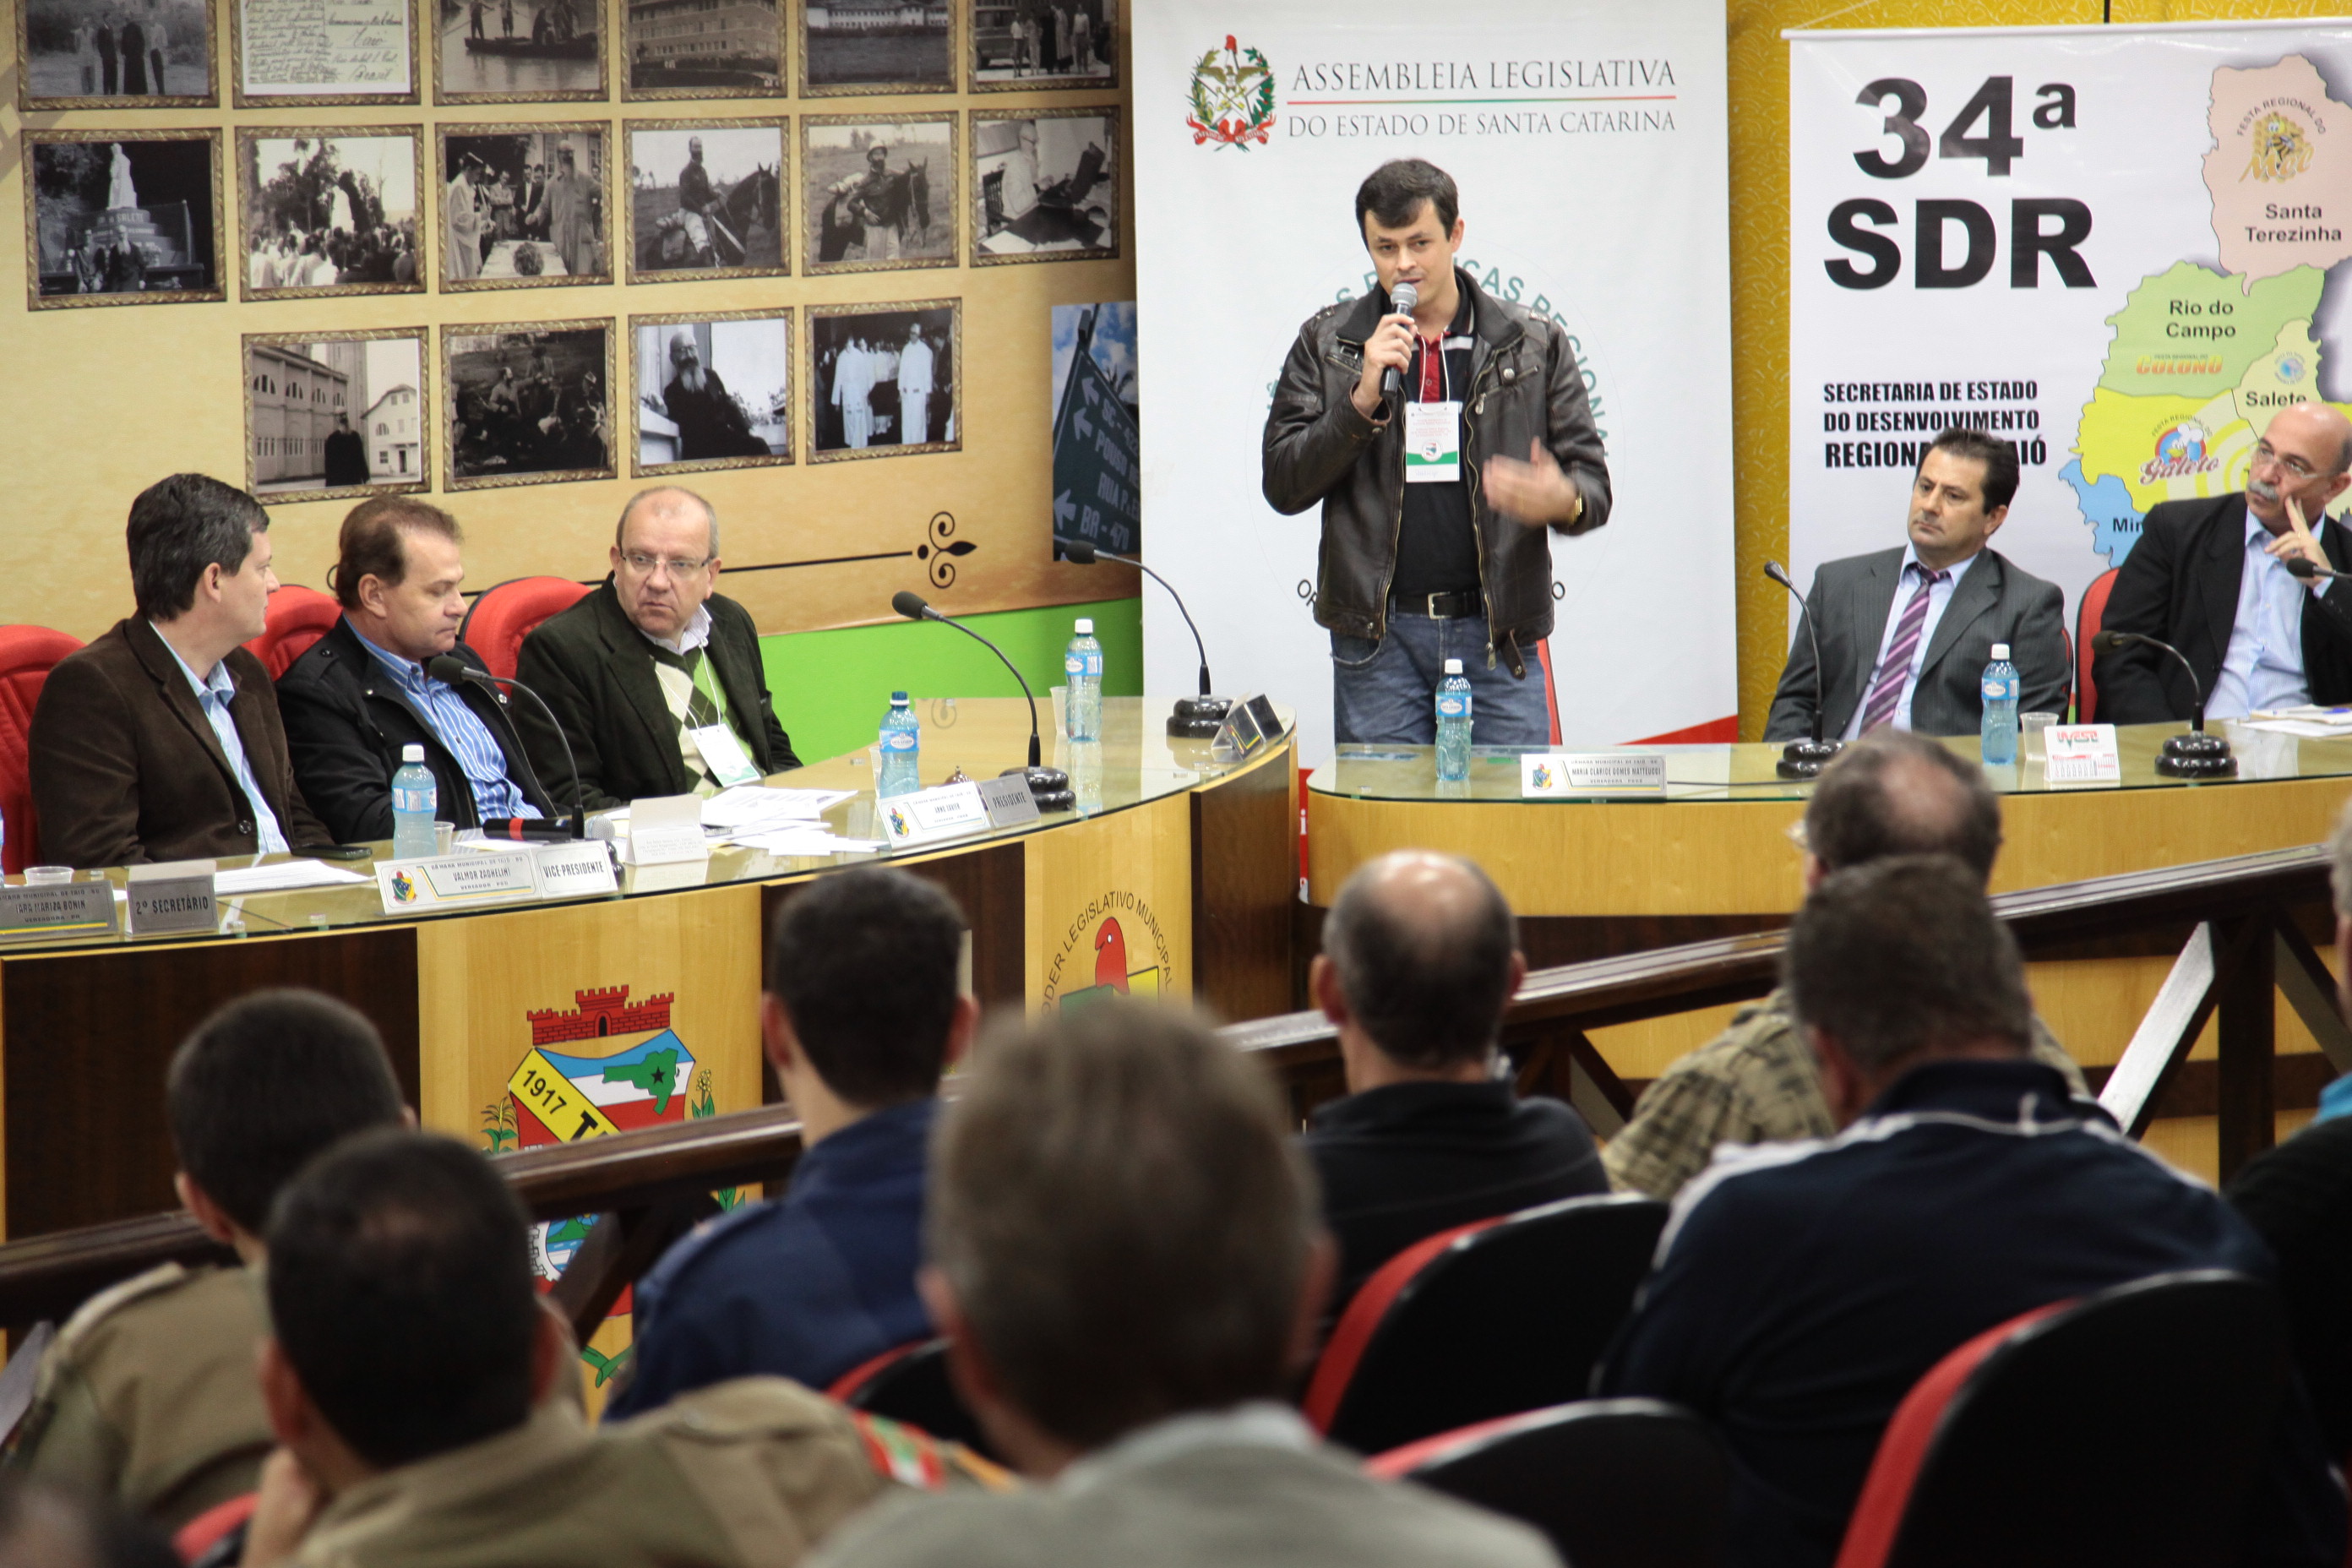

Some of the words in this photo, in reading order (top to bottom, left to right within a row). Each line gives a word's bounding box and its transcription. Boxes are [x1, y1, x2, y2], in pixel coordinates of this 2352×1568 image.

[1293, 63, 1477, 91] ASSEMBLEIA
[1491, 59, 1675, 89] LEGISLATIVA
[1289, 115, 1326, 138] DO
[1337, 113, 1429, 136] ESTADO
[1439, 112, 1468, 134] DE
[1476, 112, 1552, 133] SANTA
[1560, 109, 1675, 132] CATARINA
[2237, 106, 2262, 136] FESTA
[2262, 97, 2317, 121] REGIONAL
[2314, 117, 2326, 134] DO
[2265, 204, 2322, 219] Santa
[2245, 226, 2342, 242] Terezinha
[1823, 198, 2098, 290] SDR
[2170, 299, 2202, 315] Rio
[2209, 299, 2234, 315] do
[2166, 323, 2236, 340] Campo
[1824, 383, 1935, 402] SECRETARIA
[1940, 382, 1962, 400] DE
[1968, 380, 2038, 400] ESTADO
[2246, 391, 2307, 406] Salete
[1824, 412, 1850, 432] DO
[1856, 410, 2039, 432] DESENVOLVIMENTO
[1826, 440, 1929, 468] REGIONA
[2113, 518, 2143, 533] Mir
[1590, 767, 1611, 776] CLARICE
[992, 792, 1027, 809] PRESIDENTE
[453, 869, 479, 882] VALMOR
[15, 903, 33, 914] IARA
[35, 901, 62, 913] MARIZA
[63, 899, 86, 911] BONIN
[135, 900, 148, 915] 2º
[152, 894, 209, 914] SECRETÁRIO
[1063, 890, 1134, 953] LEGISLATIVO
[1136, 899, 1173, 992] MUNICIPAL
[522, 1070, 567, 1115] 1917
